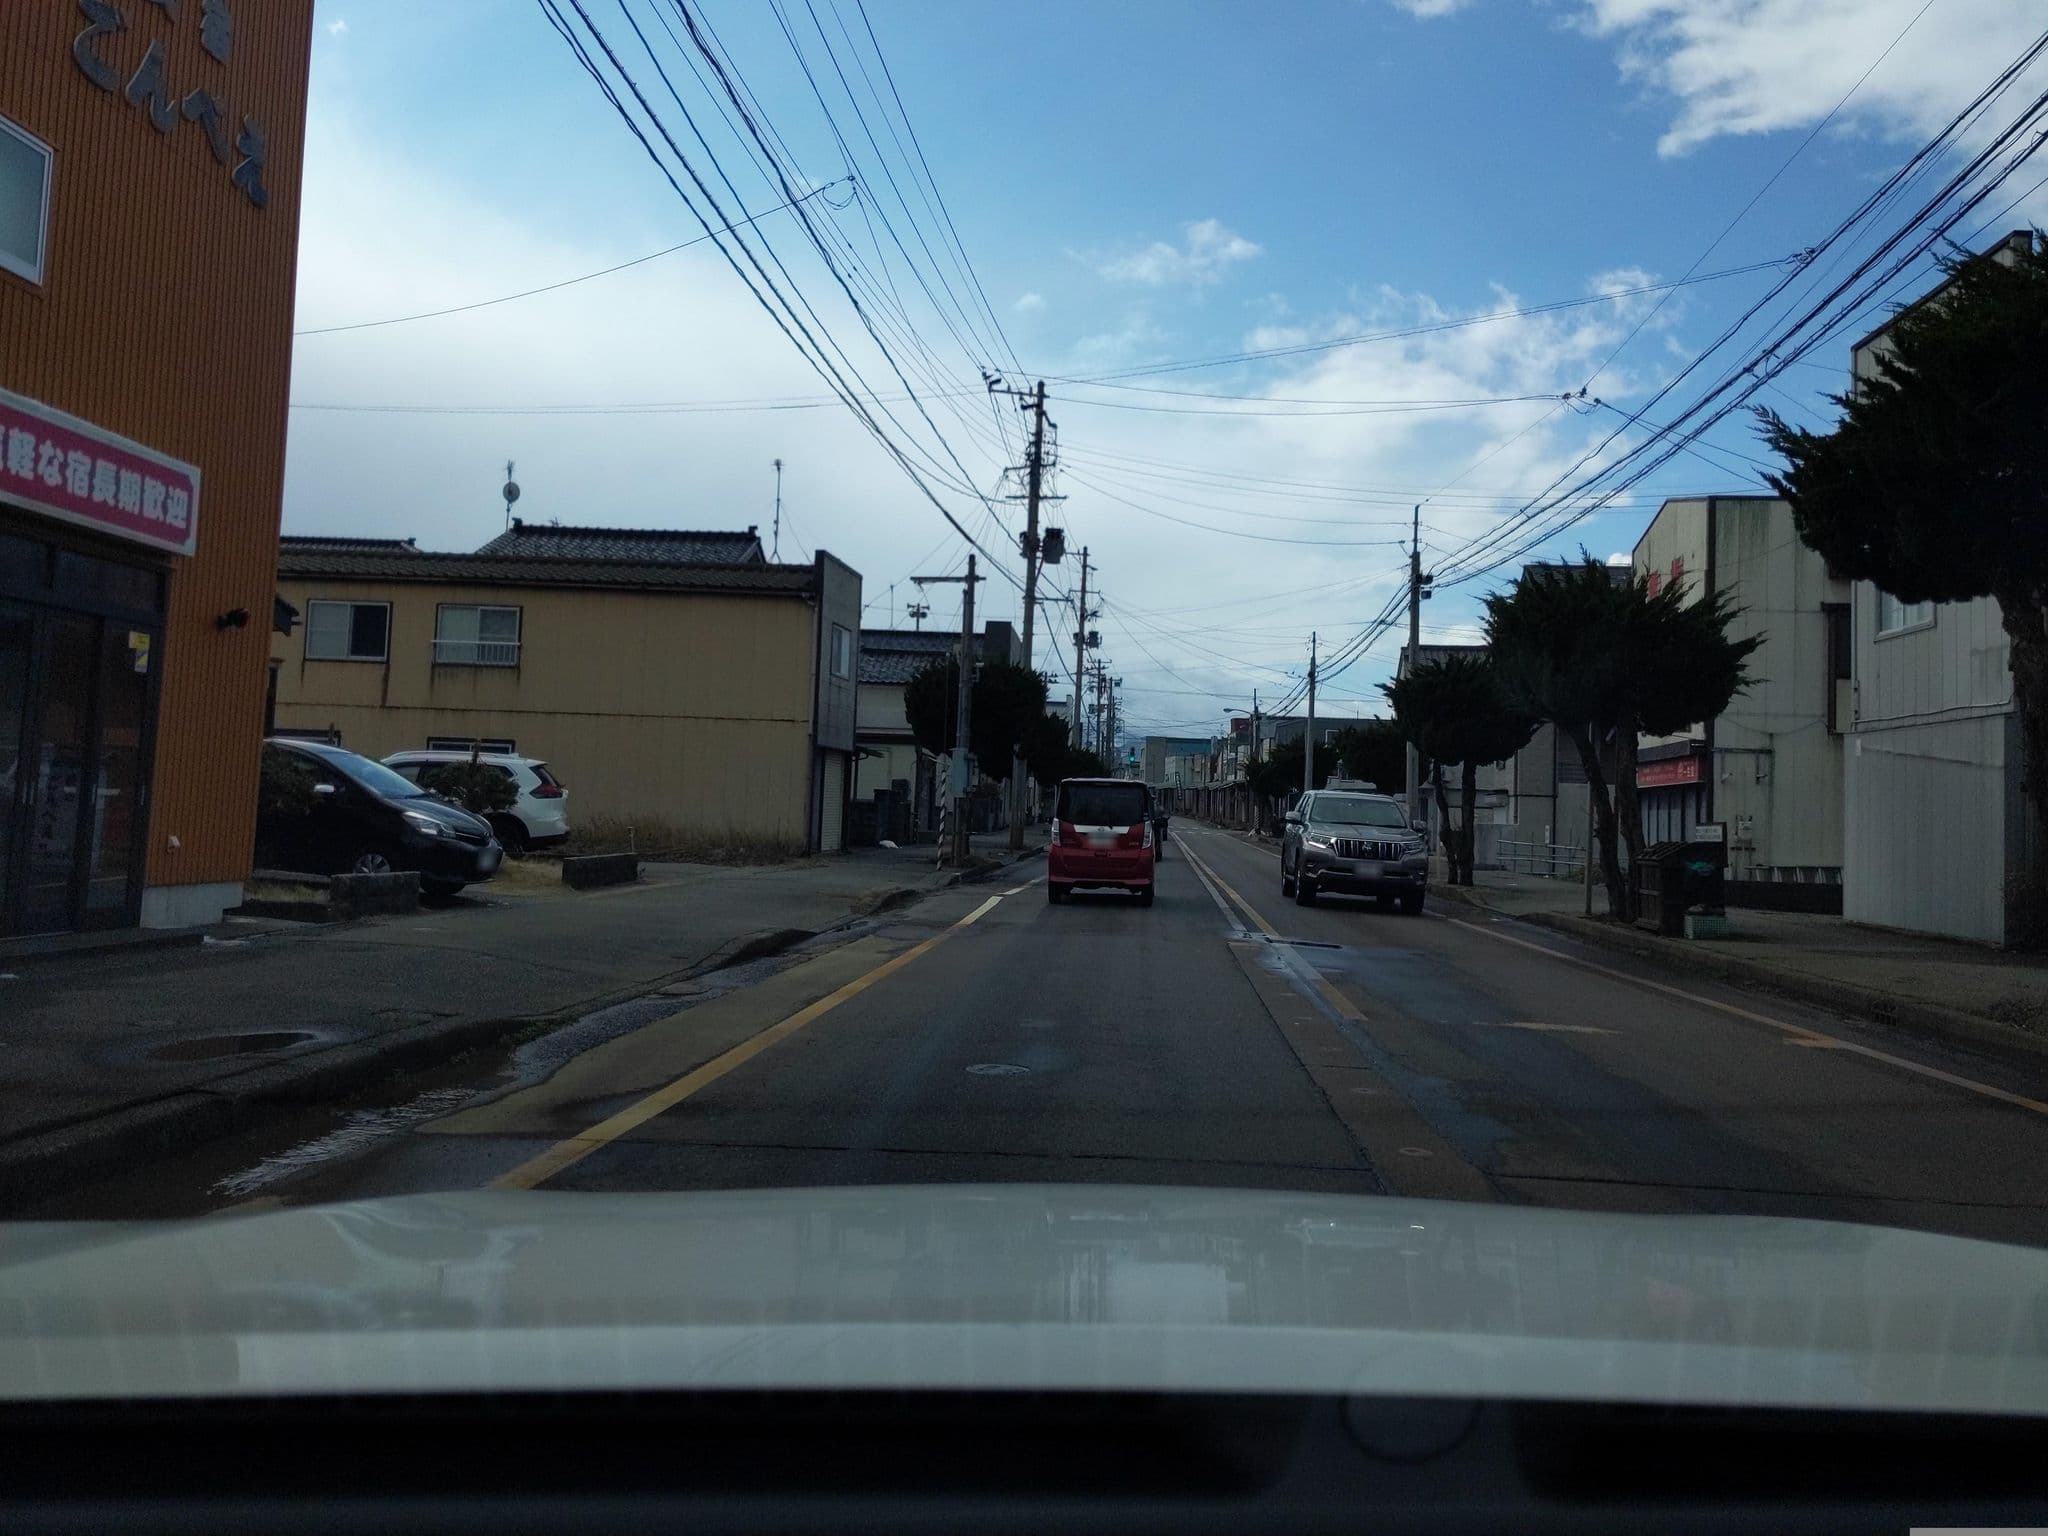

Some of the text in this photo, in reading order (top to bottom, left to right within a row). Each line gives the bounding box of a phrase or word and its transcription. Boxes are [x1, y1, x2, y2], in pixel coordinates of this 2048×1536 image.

[0, 424, 188, 528] 軽な宿長期歓迎
